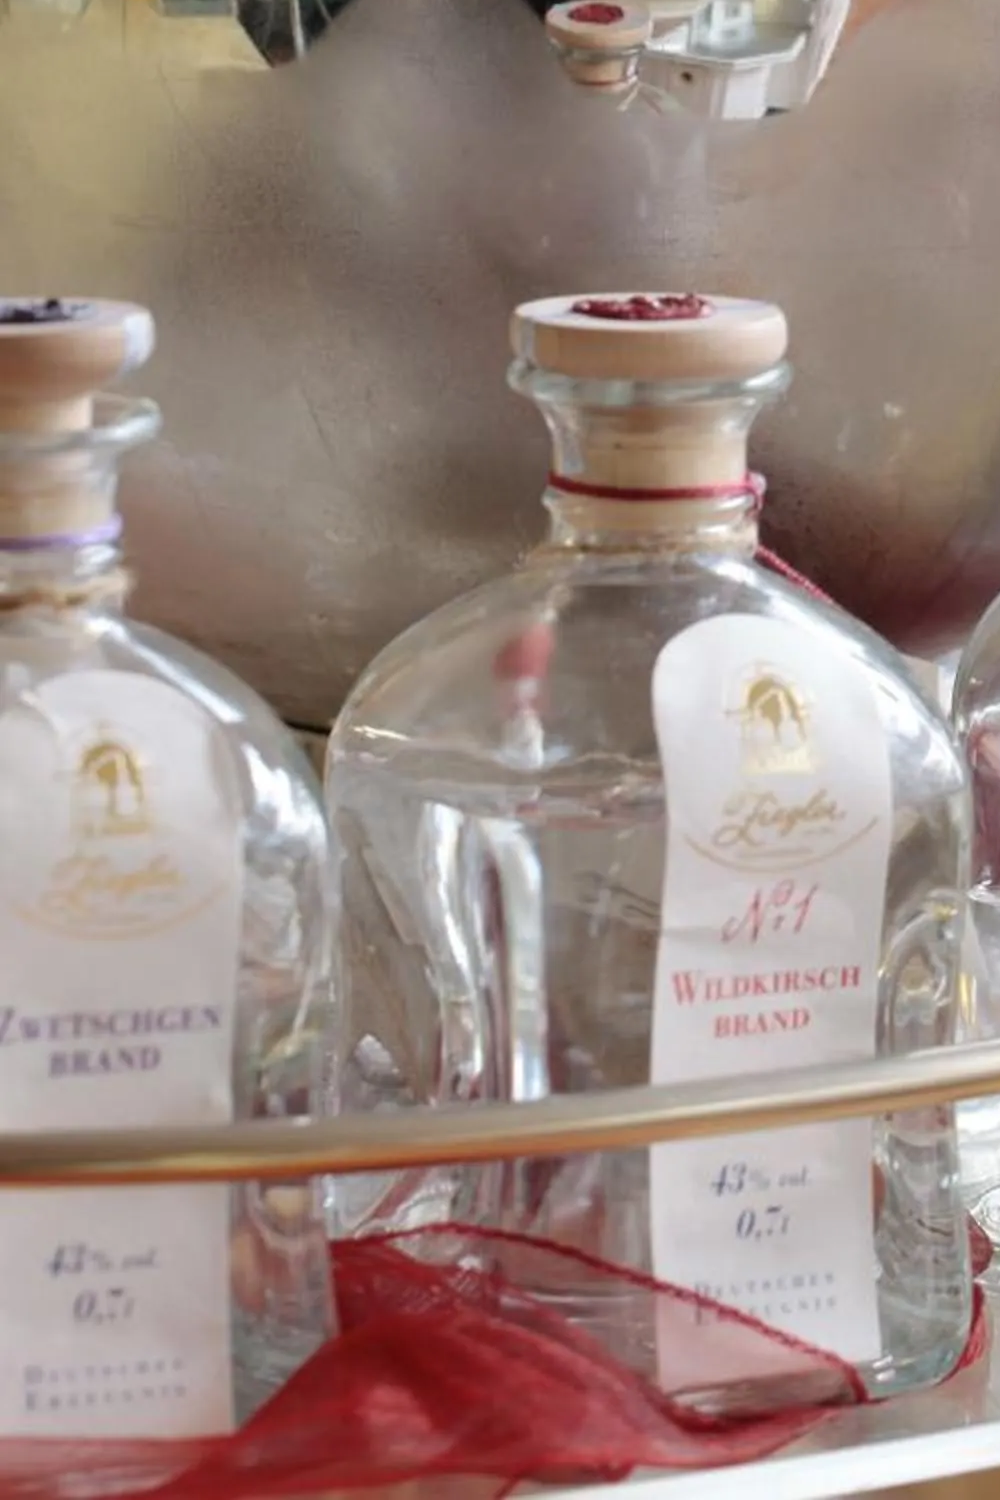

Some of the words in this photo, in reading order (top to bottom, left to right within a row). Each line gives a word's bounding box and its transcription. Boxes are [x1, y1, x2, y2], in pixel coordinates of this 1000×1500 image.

[671, 965, 862, 1005] WILDKIRSCH
[713, 1008, 811, 1039] BRAND
[49, 1045, 162, 1078] BRAND
